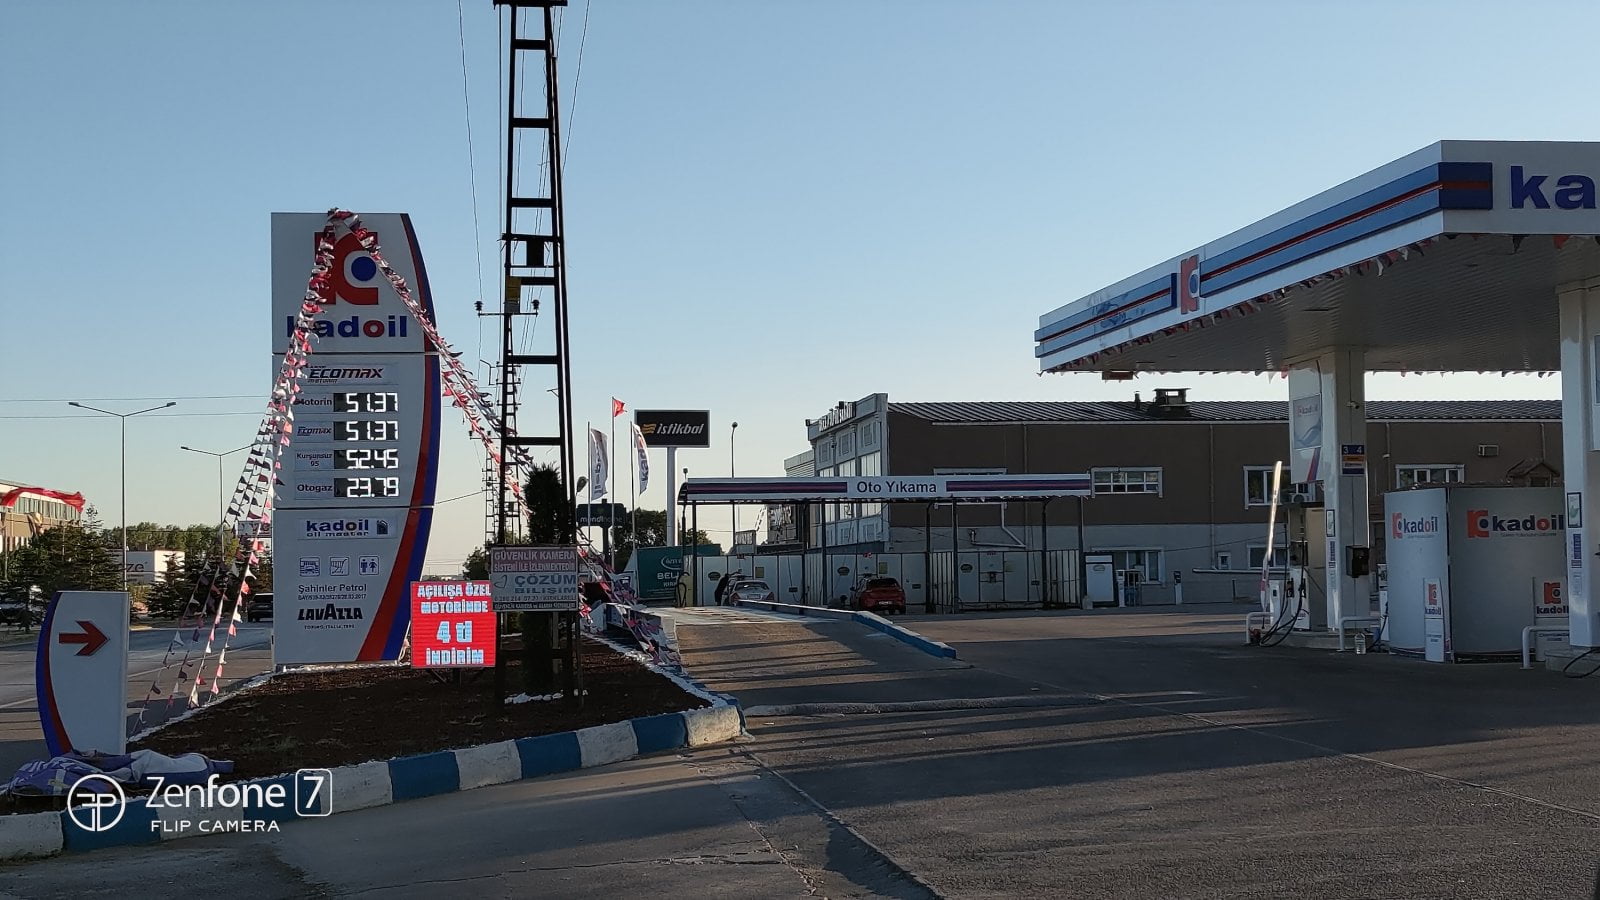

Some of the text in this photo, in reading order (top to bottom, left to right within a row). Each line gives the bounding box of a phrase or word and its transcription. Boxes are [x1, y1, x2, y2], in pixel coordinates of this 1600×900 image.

[1510, 165, 1597, 210] ka
[346, 392, 399, 413] 51.37
[346, 420, 399, 441] 51.37
[656, 423, 705, 435] istikbal
[1343, 446, 1349, 454] 3
[346, 449, 399, 470] 52.45
[296, 477, 400, 498] Otogaz 23.79
[856, 480, 938, 493] Oto Yıkama
[306, 519, 369, 532] kadoil
[1403, 515, 1438, 534] kadoil
[1492, 514, 1565, 532] kadoil
[494, 550, 576, 561] GÜVENLİK KAMERA
[298, 583, 367, 594] Şahinler Petrol
[514, 573, 576, 588] ÇÖZÜM
[417, 582, 492, 599] AÇILIŞA ÖZEL
[297, 603, 363, 621] LAVAZZA
[420, 599, 489, 614] MOTORİNDE
[436, 620, 451, 643] 4
[425, 647, 485, 666] İNDİRİM
